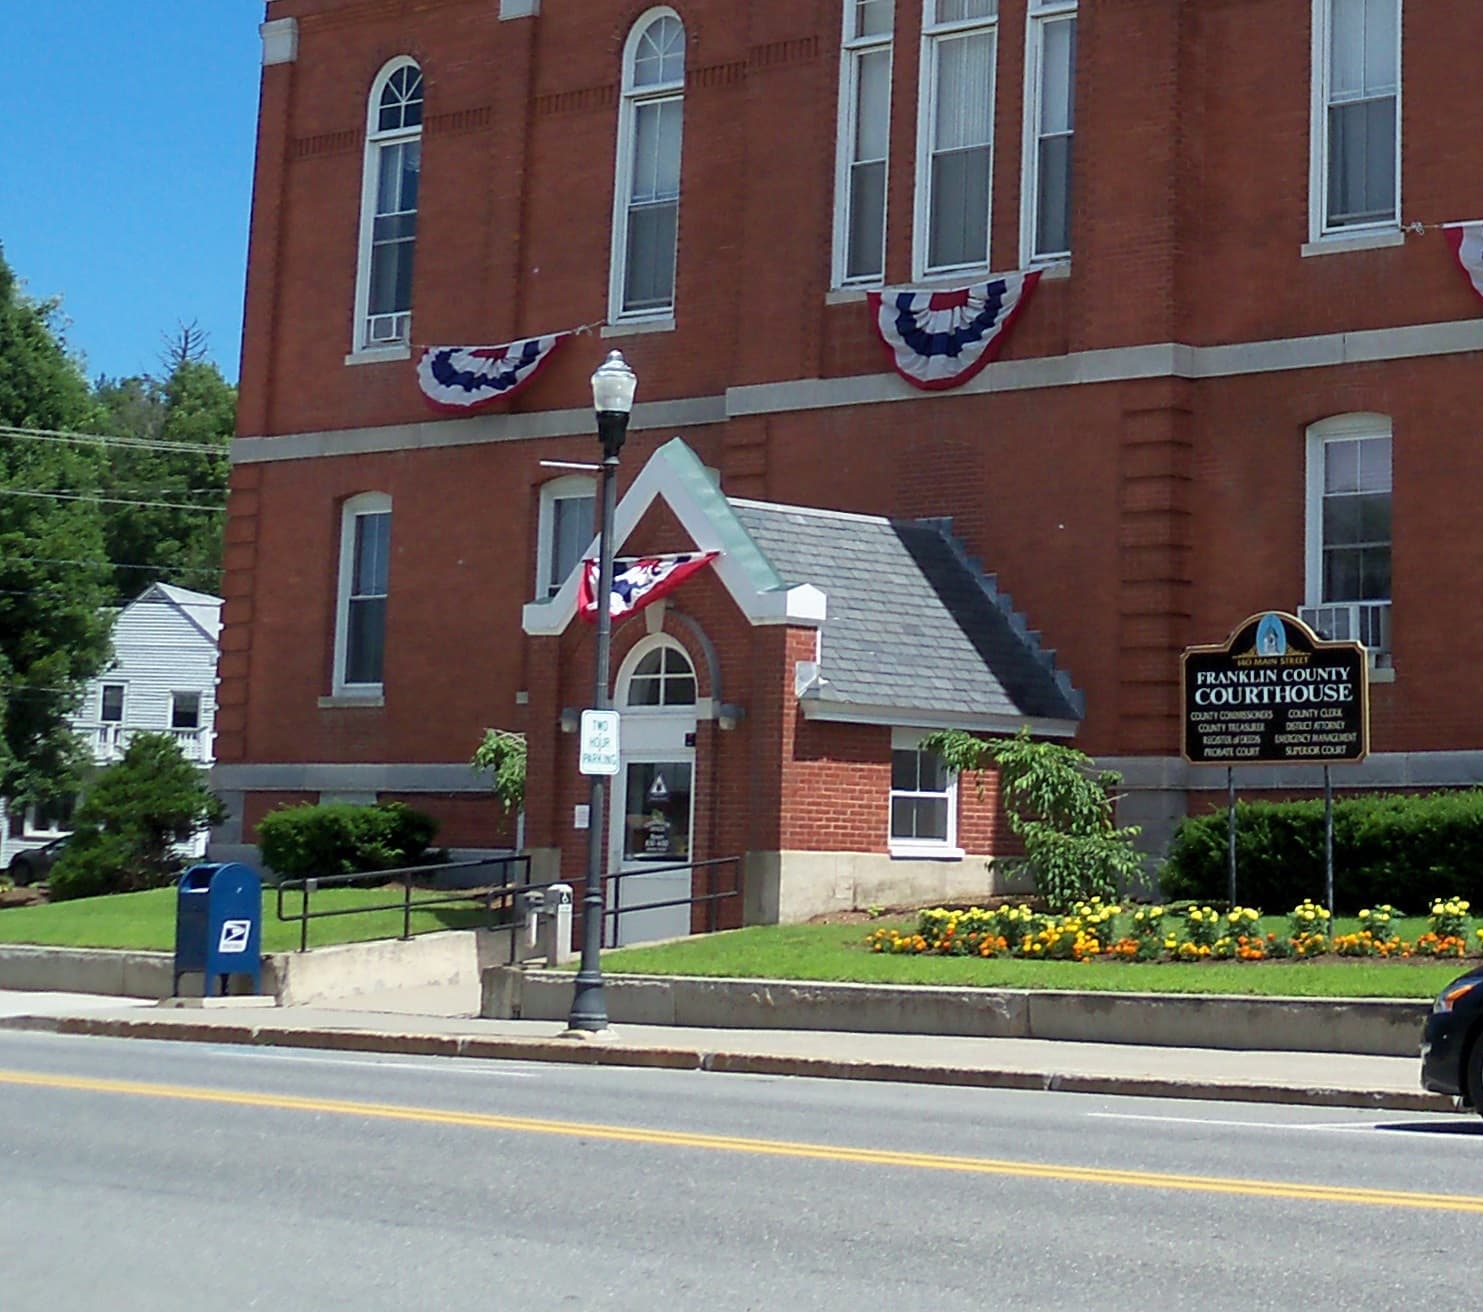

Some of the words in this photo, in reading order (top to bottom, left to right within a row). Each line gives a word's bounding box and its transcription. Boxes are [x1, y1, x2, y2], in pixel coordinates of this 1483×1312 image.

[1254, 658, 1277, 666] MAIN
[1280, 656, 1309, 665] STREET
[1197, 670, 1277, 684] FRANKLIN
[1282, 667, 1350, 682] COUNTY
[1194, 683, 1353, 705] COURTHOUSE
[1190, 712, 1218, 721] COUNTY
[1220, 710, 1274, 720] COMMISSIONERS
[1288, 709, 1318, 718] COUNTY
[1320, 708, 1343, 717] CLERK
[592, 719, 608, 732] TWO
[1198, 723, 1226, 733] COUNTY
[1228, 722, 1265, 732] TREASURER
[1286, 721, 1312, 731] DISTRICT
[1313, 720, 1345, 730] ATTORNEY
[590, 737, 610, 748] HOUR
[1274, 734, 1310, 744] EMERGENCY
[1312, 732, 1357, 742] MANAGEMENT
[1204, 747, 1234, 757] PROBATE
[1235, 746, 1260, 756] COURT
[1285, 745, 1320, 755] SUPERIOR
[1321, 745, 1347, 755] COURT
[583, 753, 617, 765] PARKING
